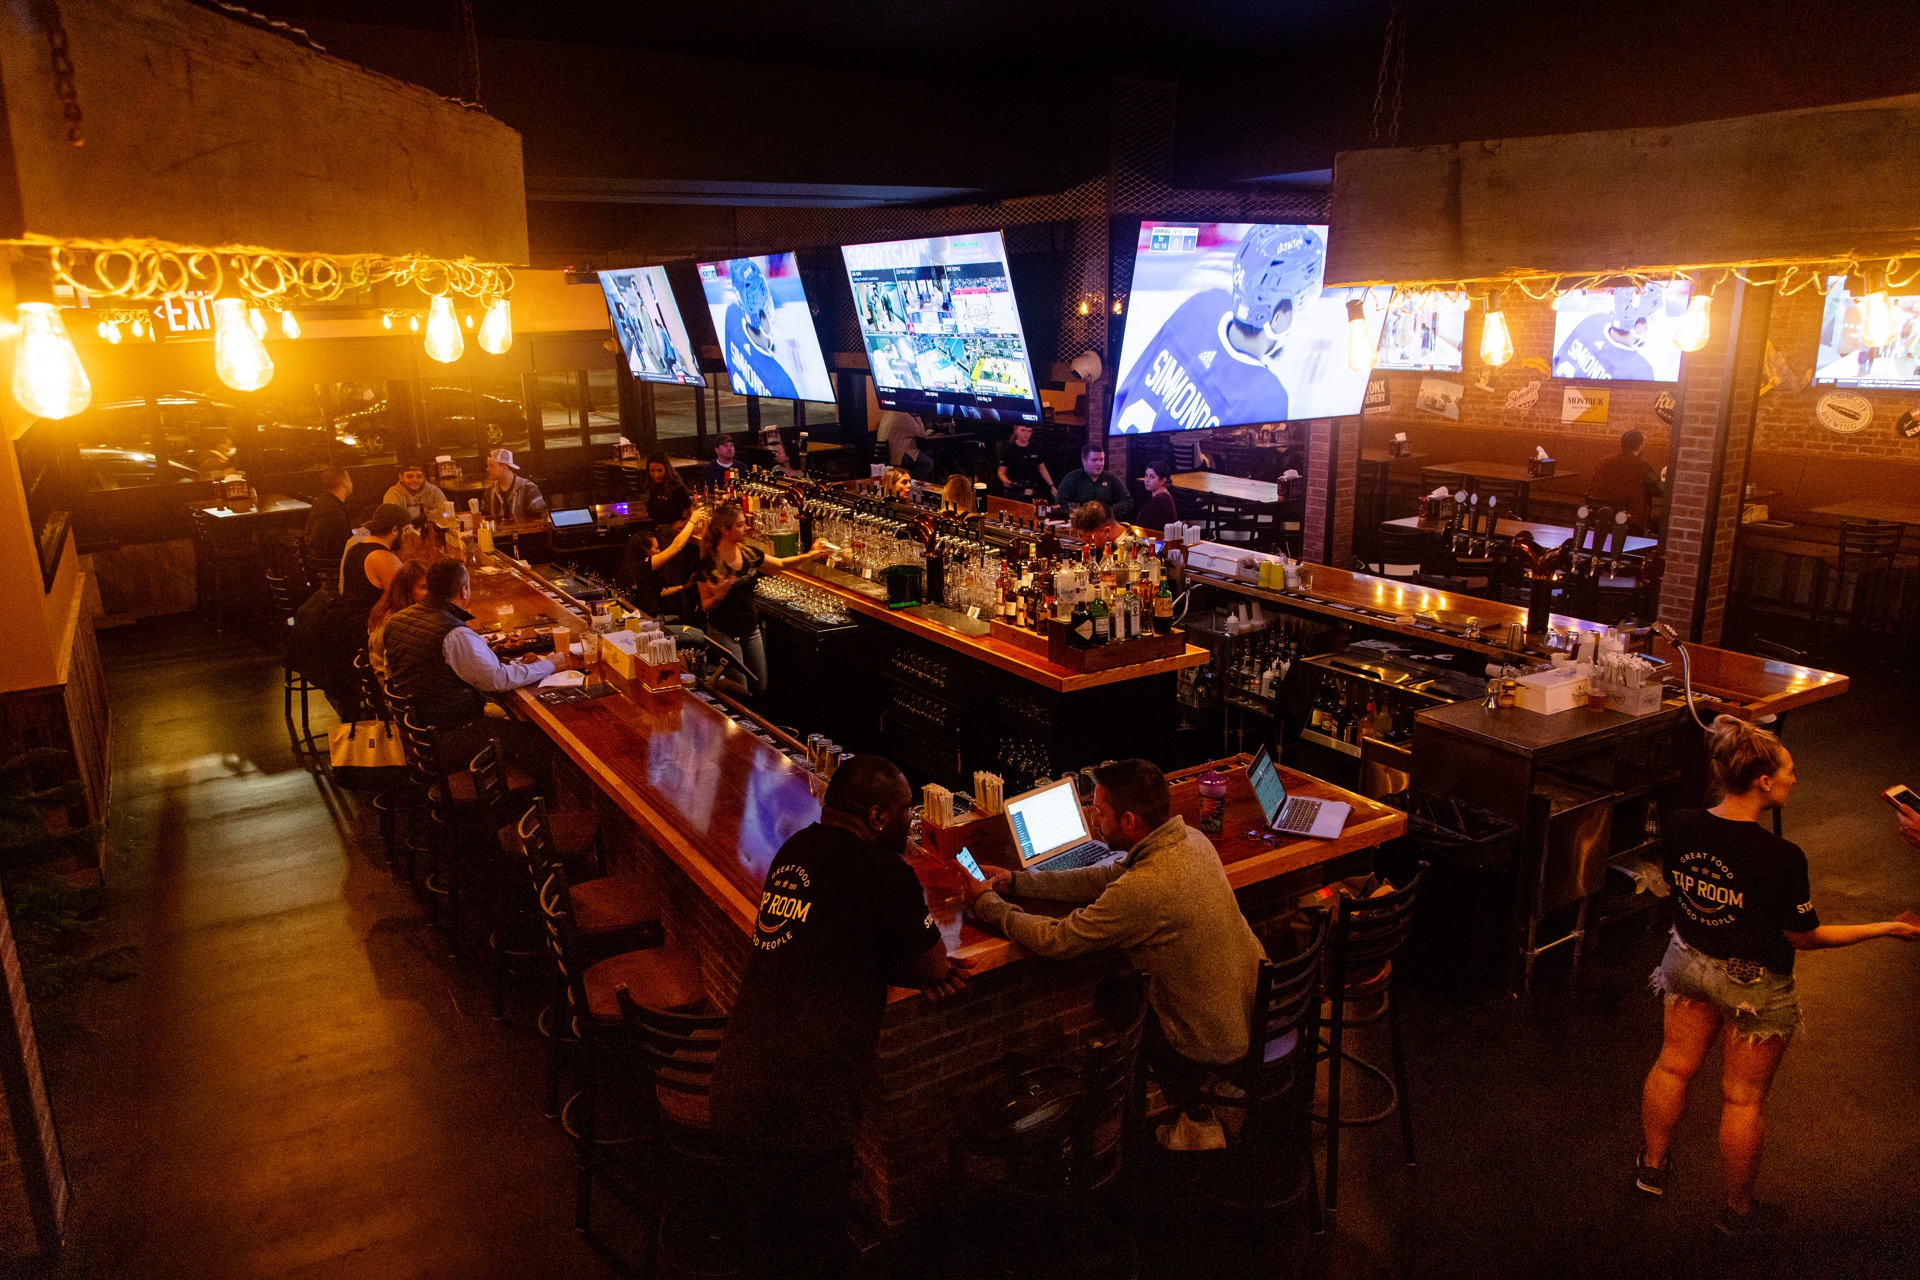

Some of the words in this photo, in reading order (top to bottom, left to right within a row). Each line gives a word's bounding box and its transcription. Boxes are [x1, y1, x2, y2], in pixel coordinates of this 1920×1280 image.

[730, 341, 772, 397] SIMMOND
[1568, 397, 1603, 406] MONTAUK
[1821, 411, 1857, 430] BREWING
[771, 865, 795, 879] GREAT
[795, 866, 811, 887] FOOD
[1680, 852, 1708, 863] GREAT
[1711, 856, 1733, 879] FOOD
[1671, 870, 1694, 891] TAP
[1697, 880, 1743, 908] ROOM
[768, 894, 812, 922] ROOM
[1701, 914, 1735, 926] PEOPLE
[761, 931, 793, 950] PEOPLE
